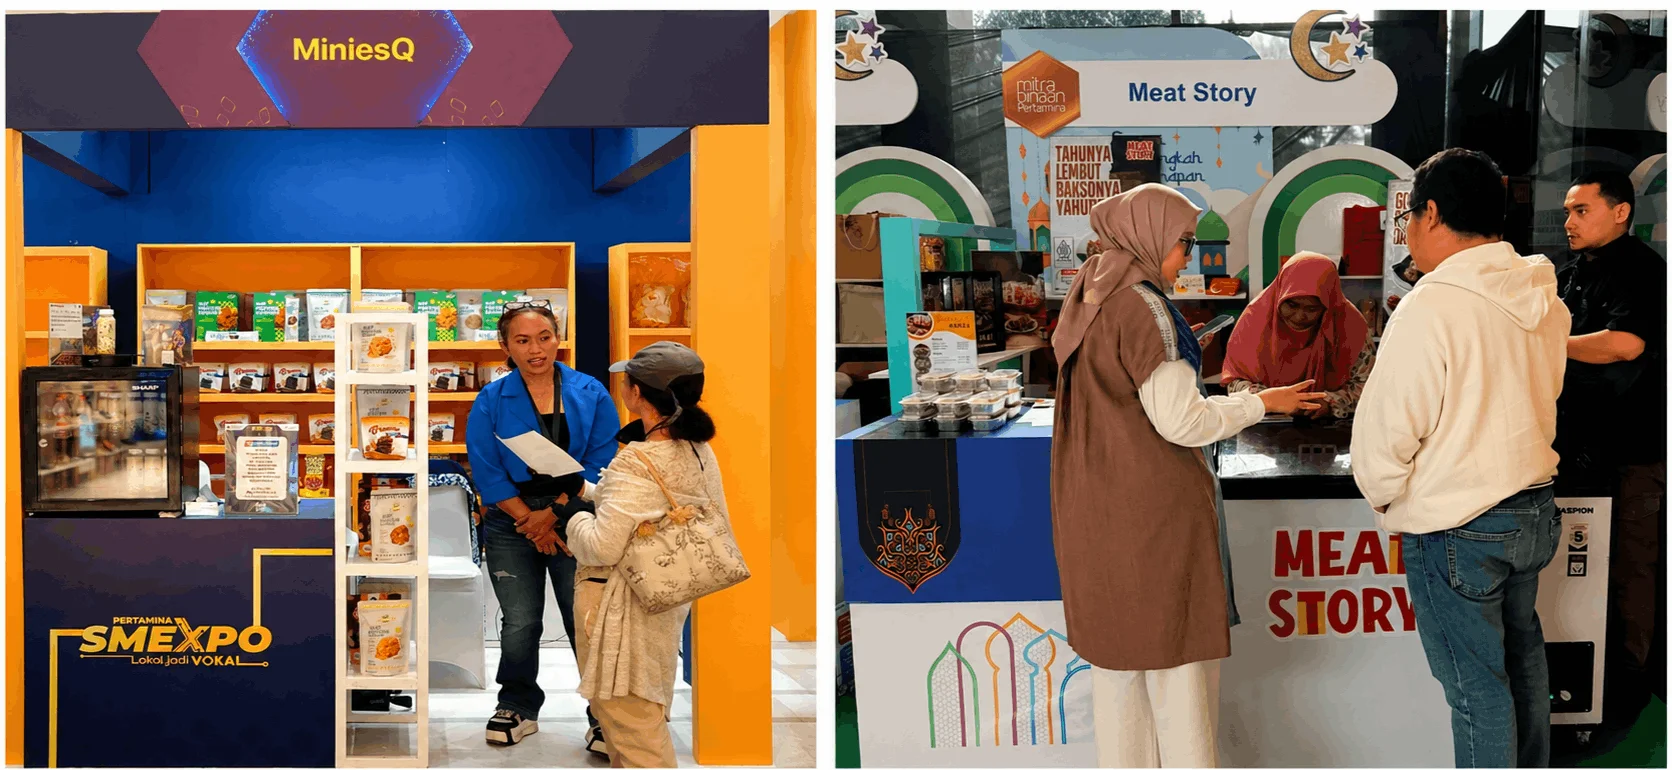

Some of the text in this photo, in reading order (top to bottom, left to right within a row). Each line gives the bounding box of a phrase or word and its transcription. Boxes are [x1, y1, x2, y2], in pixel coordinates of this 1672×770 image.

[293, 37, 415, 62] MiniesQ
[1016, 76, 1056, 92] mitra
[1016, 90, 1066, 104] binaan
[1128, 82, 1257, 107] Meat Story
[1055, 145, 1111, 163] TAHUNYA
[1056, 163, 1101, 180] LEMBUT
[1056, 181, 1121, 198] BAKSONYA
[1056, 199, 1103, 216] YAHU
[1574, 530, 1584, 542] 5
[112, 616, 173, 625] PERTAMINA
[1268, 587, 1416, 638] STORY
[79, 617, 272, 653] SMEXPO
[191, 655, 242, 667] VOKAL
